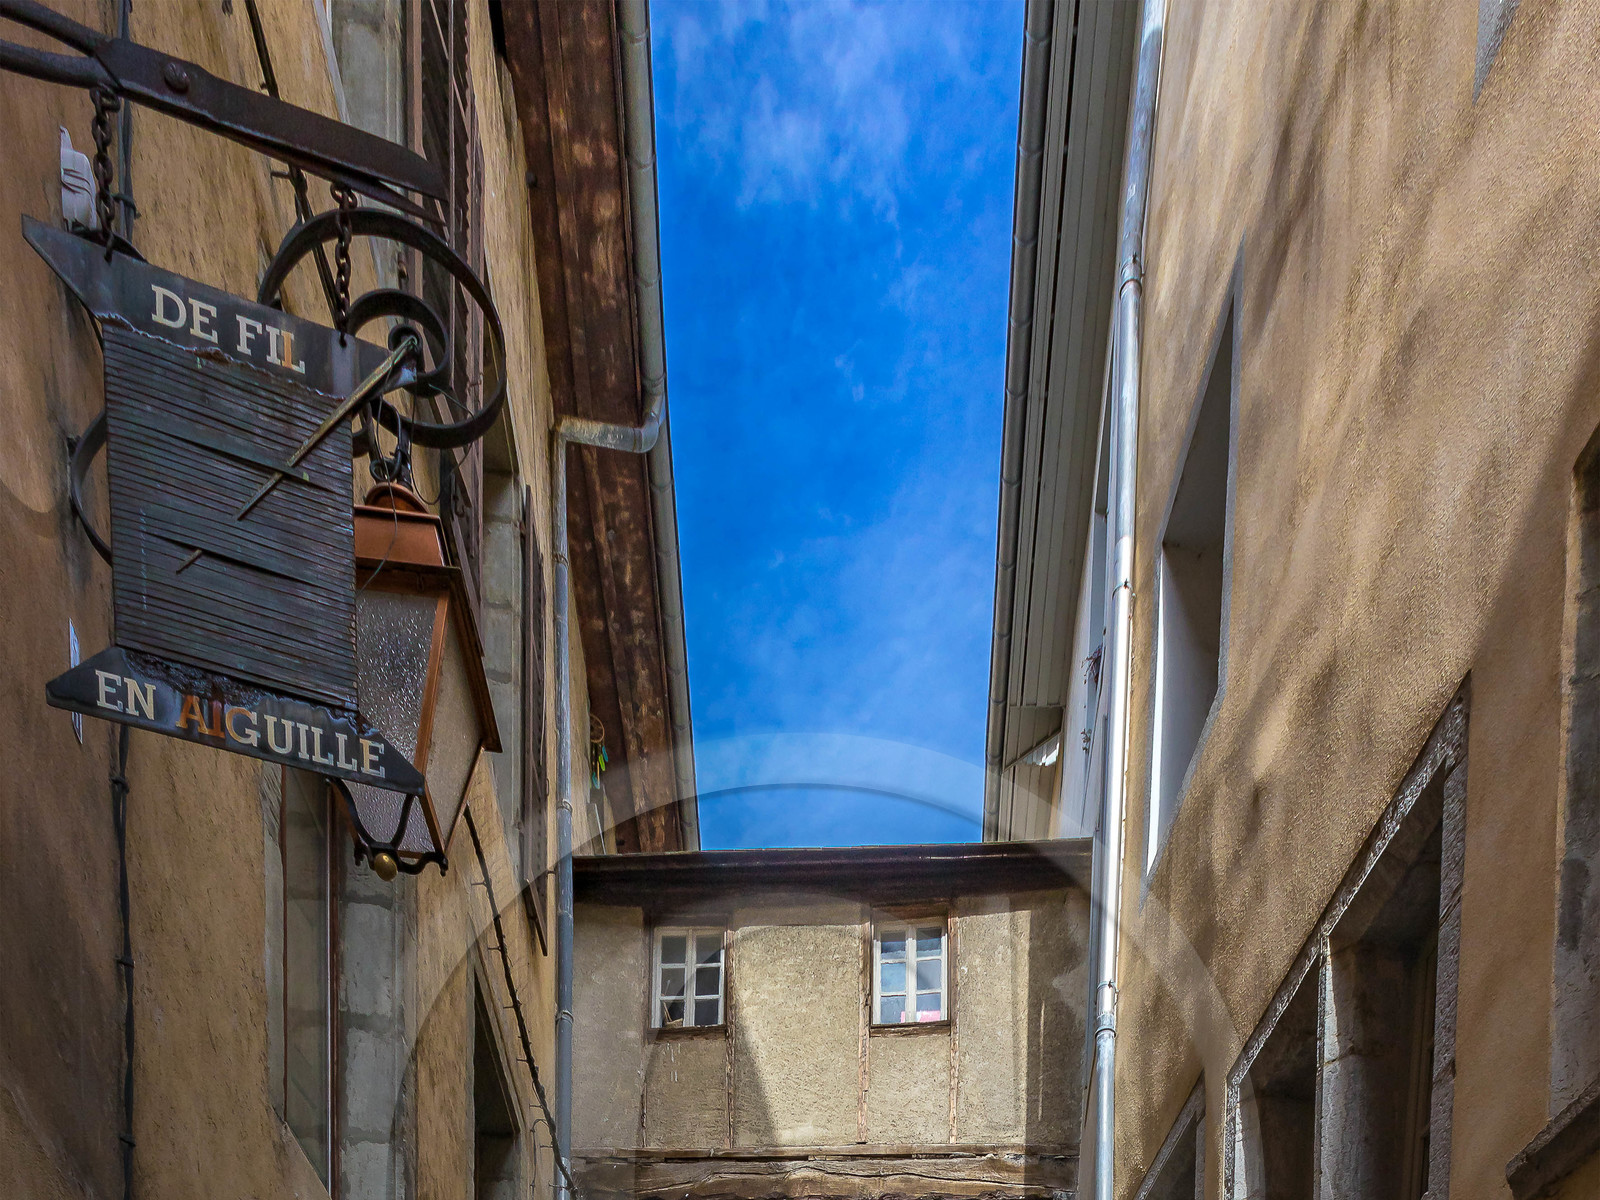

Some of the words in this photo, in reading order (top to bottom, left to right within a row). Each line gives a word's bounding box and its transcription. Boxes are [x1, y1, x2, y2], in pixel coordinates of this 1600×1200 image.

[151, 284, 219, 344] DE
[235, 313, 306, 375] FIL
[95, 669, 156, 720] EN
[175, 694, 386, 779] AIGUILLE
